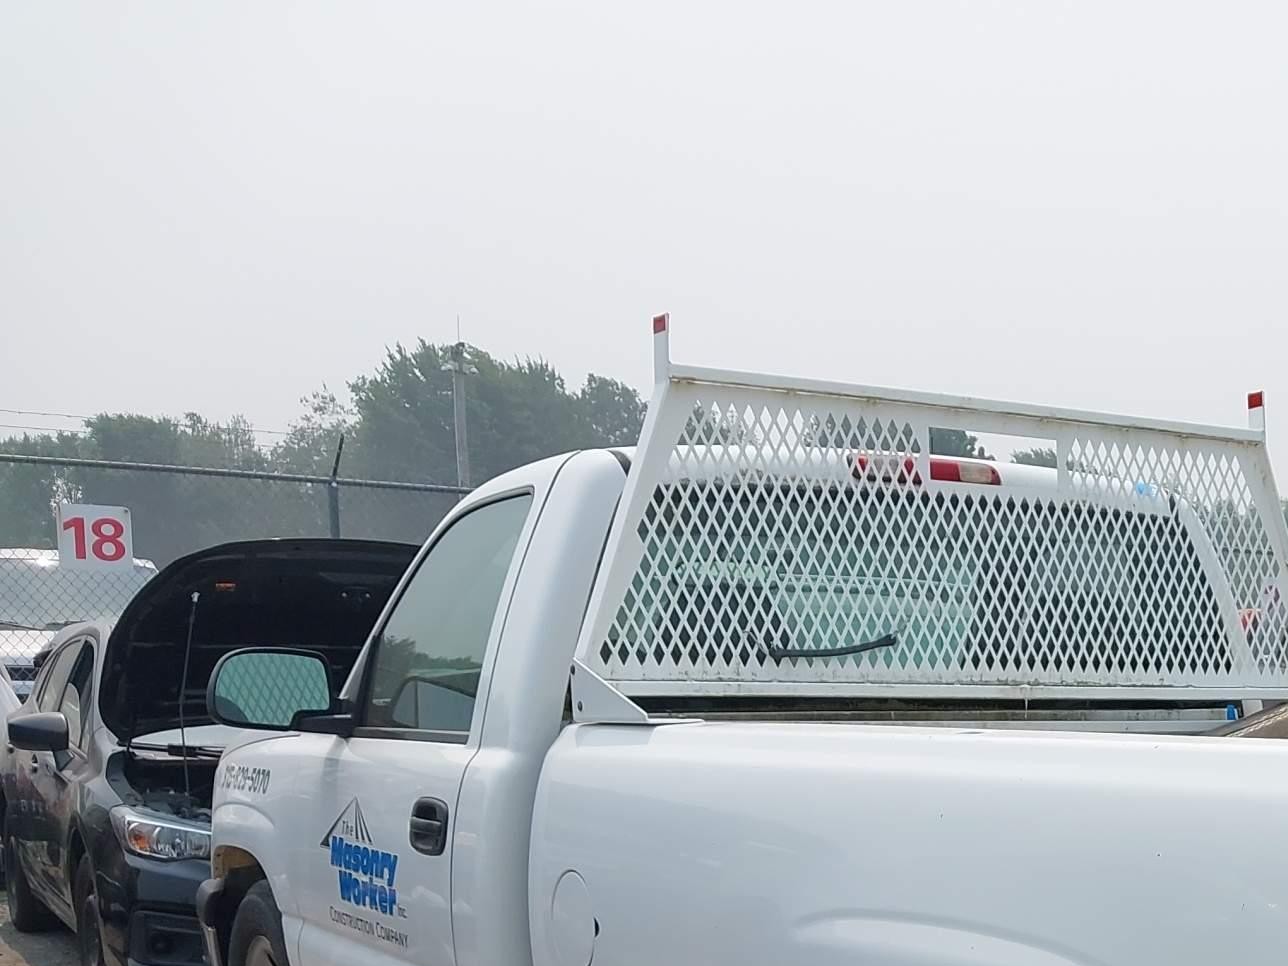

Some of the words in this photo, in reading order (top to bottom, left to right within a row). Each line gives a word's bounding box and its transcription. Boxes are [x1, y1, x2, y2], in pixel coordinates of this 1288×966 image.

[63, 517, 126, 562] 18
[342, 820, 354, 836] The
[331, 836, 398, 887] Masonry
[338, 870, 396, 916] Worker
